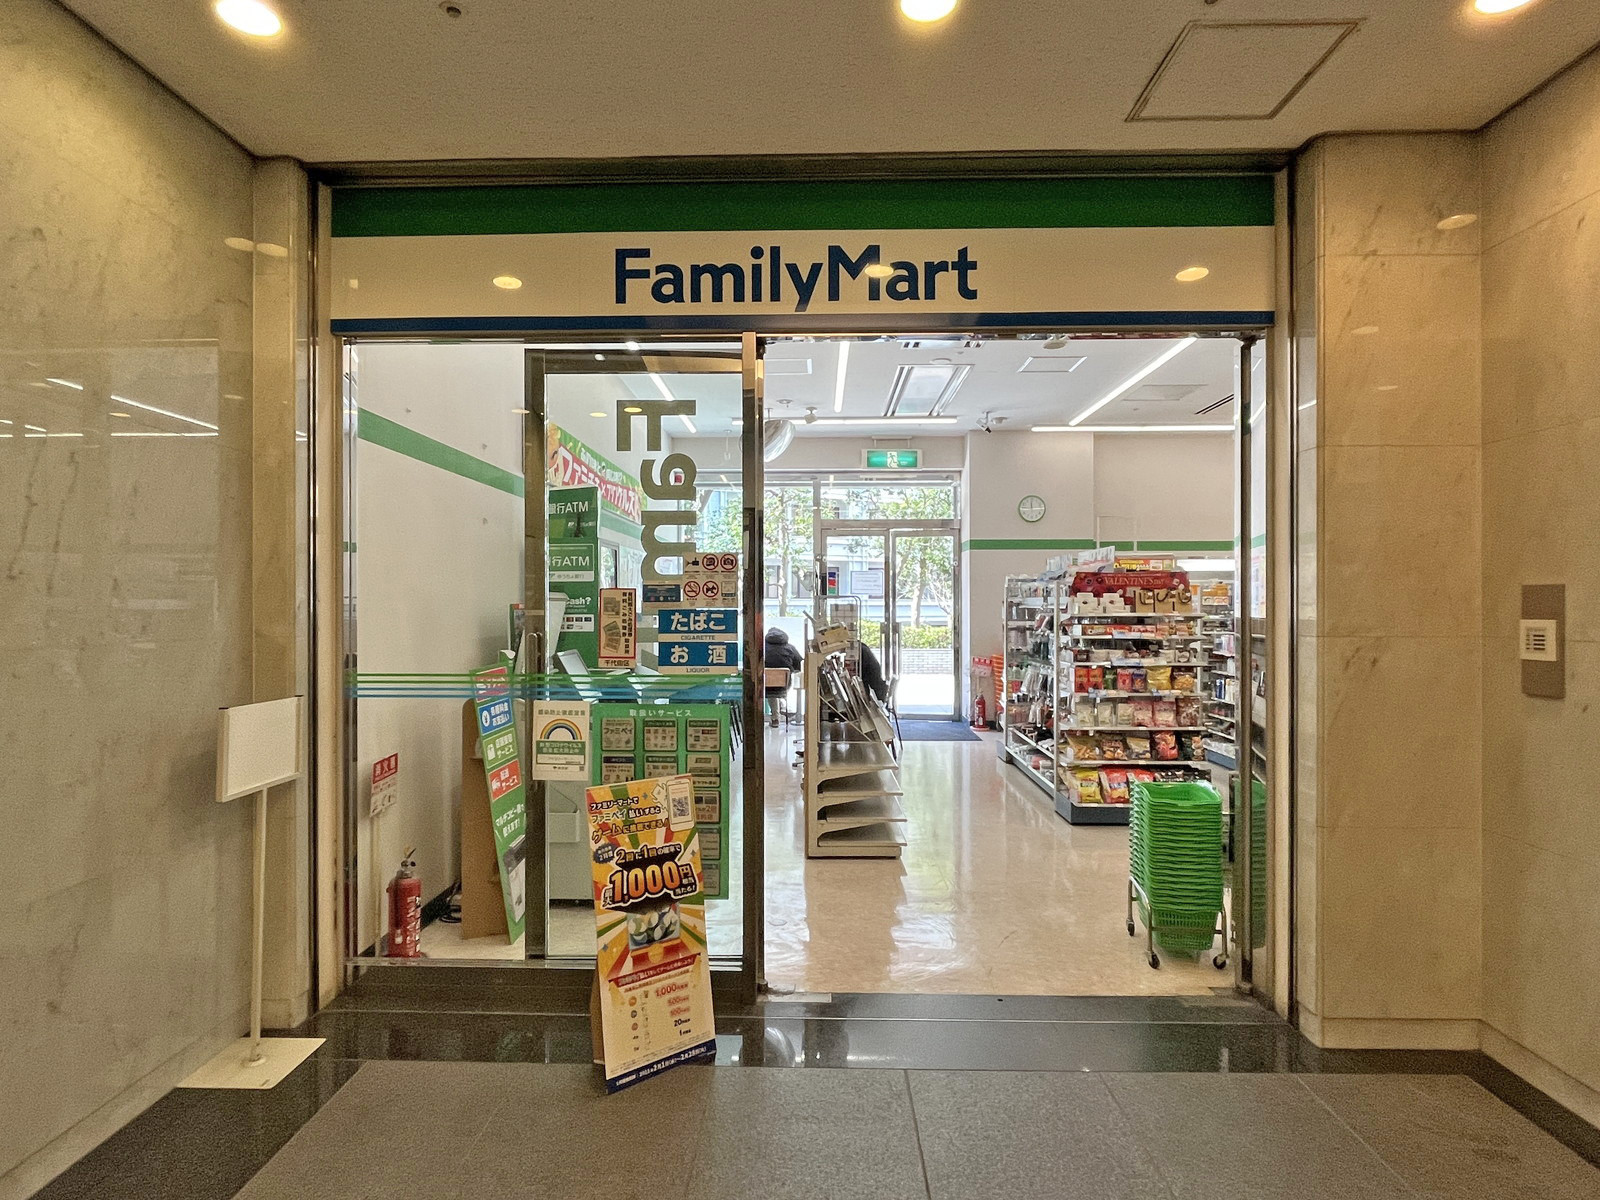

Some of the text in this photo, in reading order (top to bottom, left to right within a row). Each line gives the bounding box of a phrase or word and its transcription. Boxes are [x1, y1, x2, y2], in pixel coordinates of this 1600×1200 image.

[614, 244, 978, 312] FamilyMart
[551, 555, 589, 567] 行ATM
[670, 612, 726, 632] たばこ
[592, 809, 627, 823] ファミペイ
